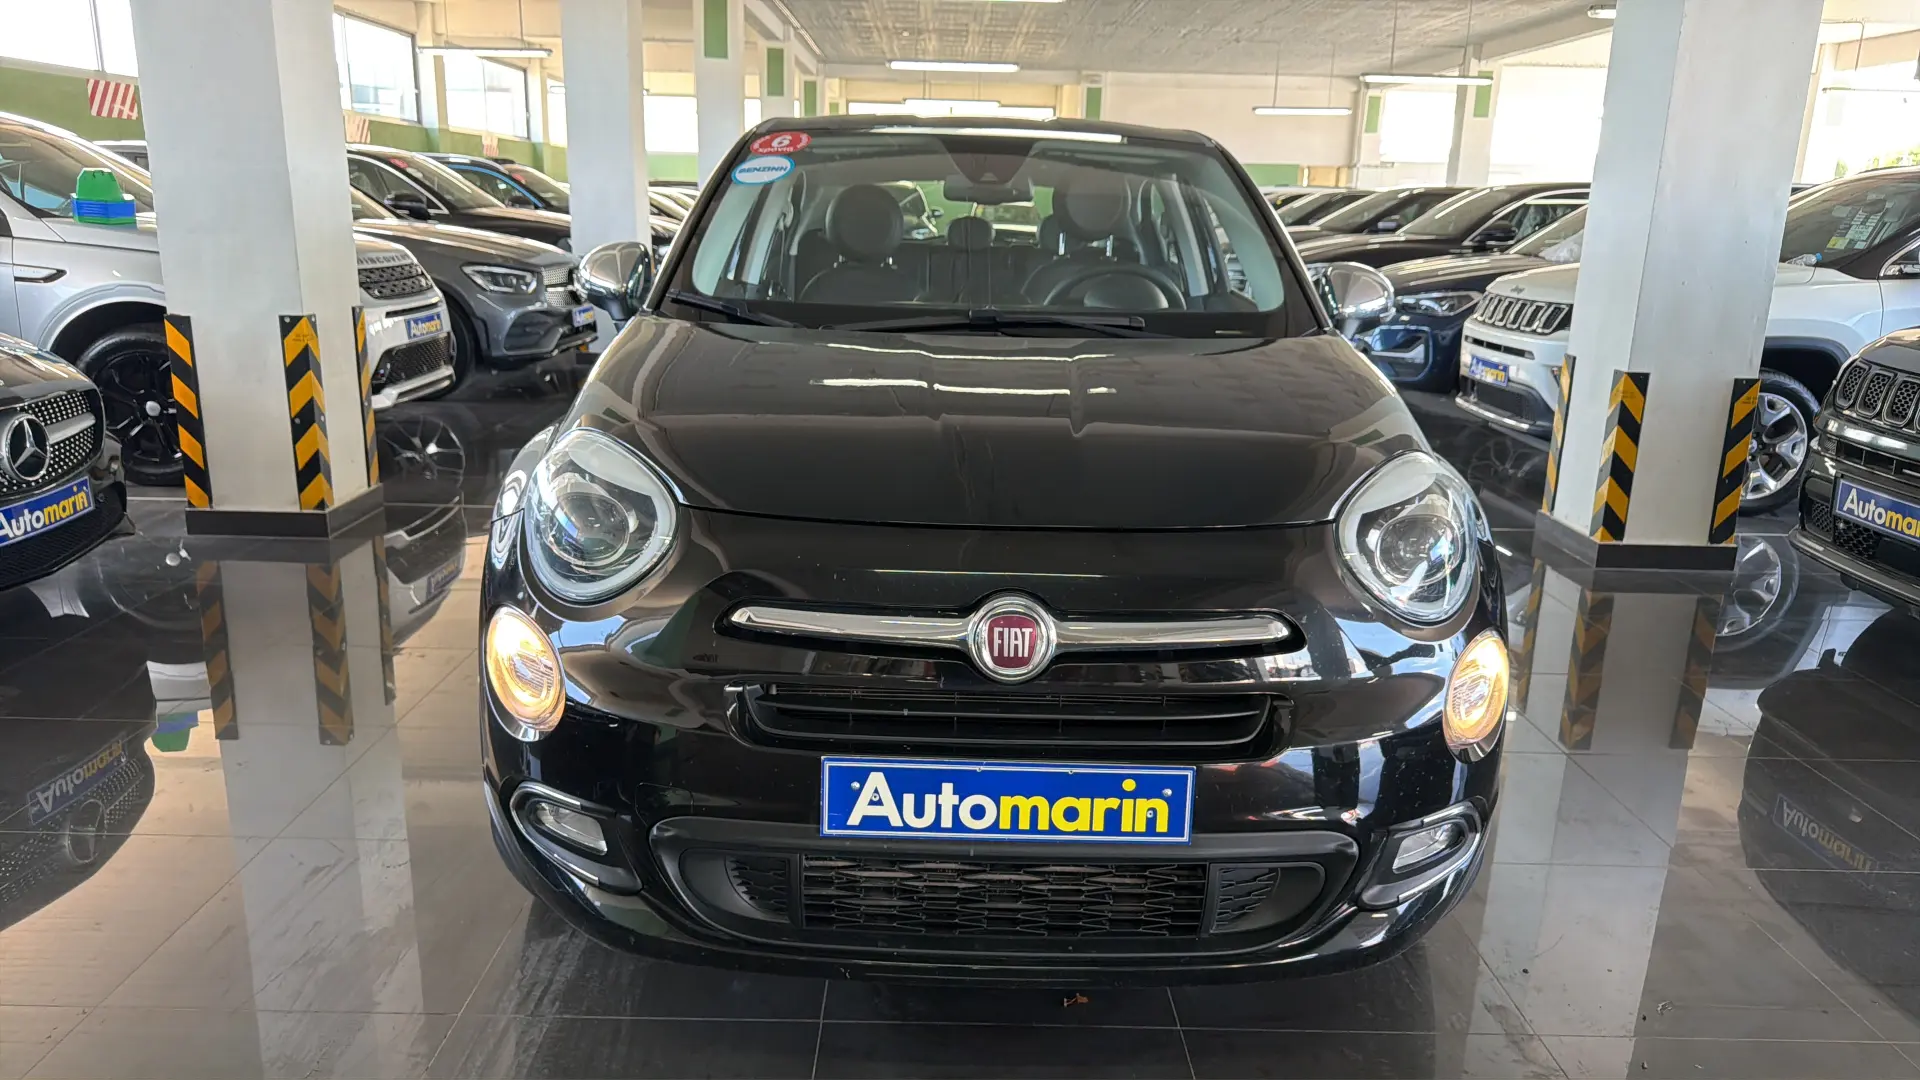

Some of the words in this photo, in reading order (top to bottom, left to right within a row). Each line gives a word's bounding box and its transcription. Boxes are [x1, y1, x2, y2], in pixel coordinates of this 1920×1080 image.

[771, 135, 793, 148] 6
[1843, 488, 1920, 537] Automa
[993, 627, 1033, 657] FIAT
[847, 771, 1169, 833] Automarin
